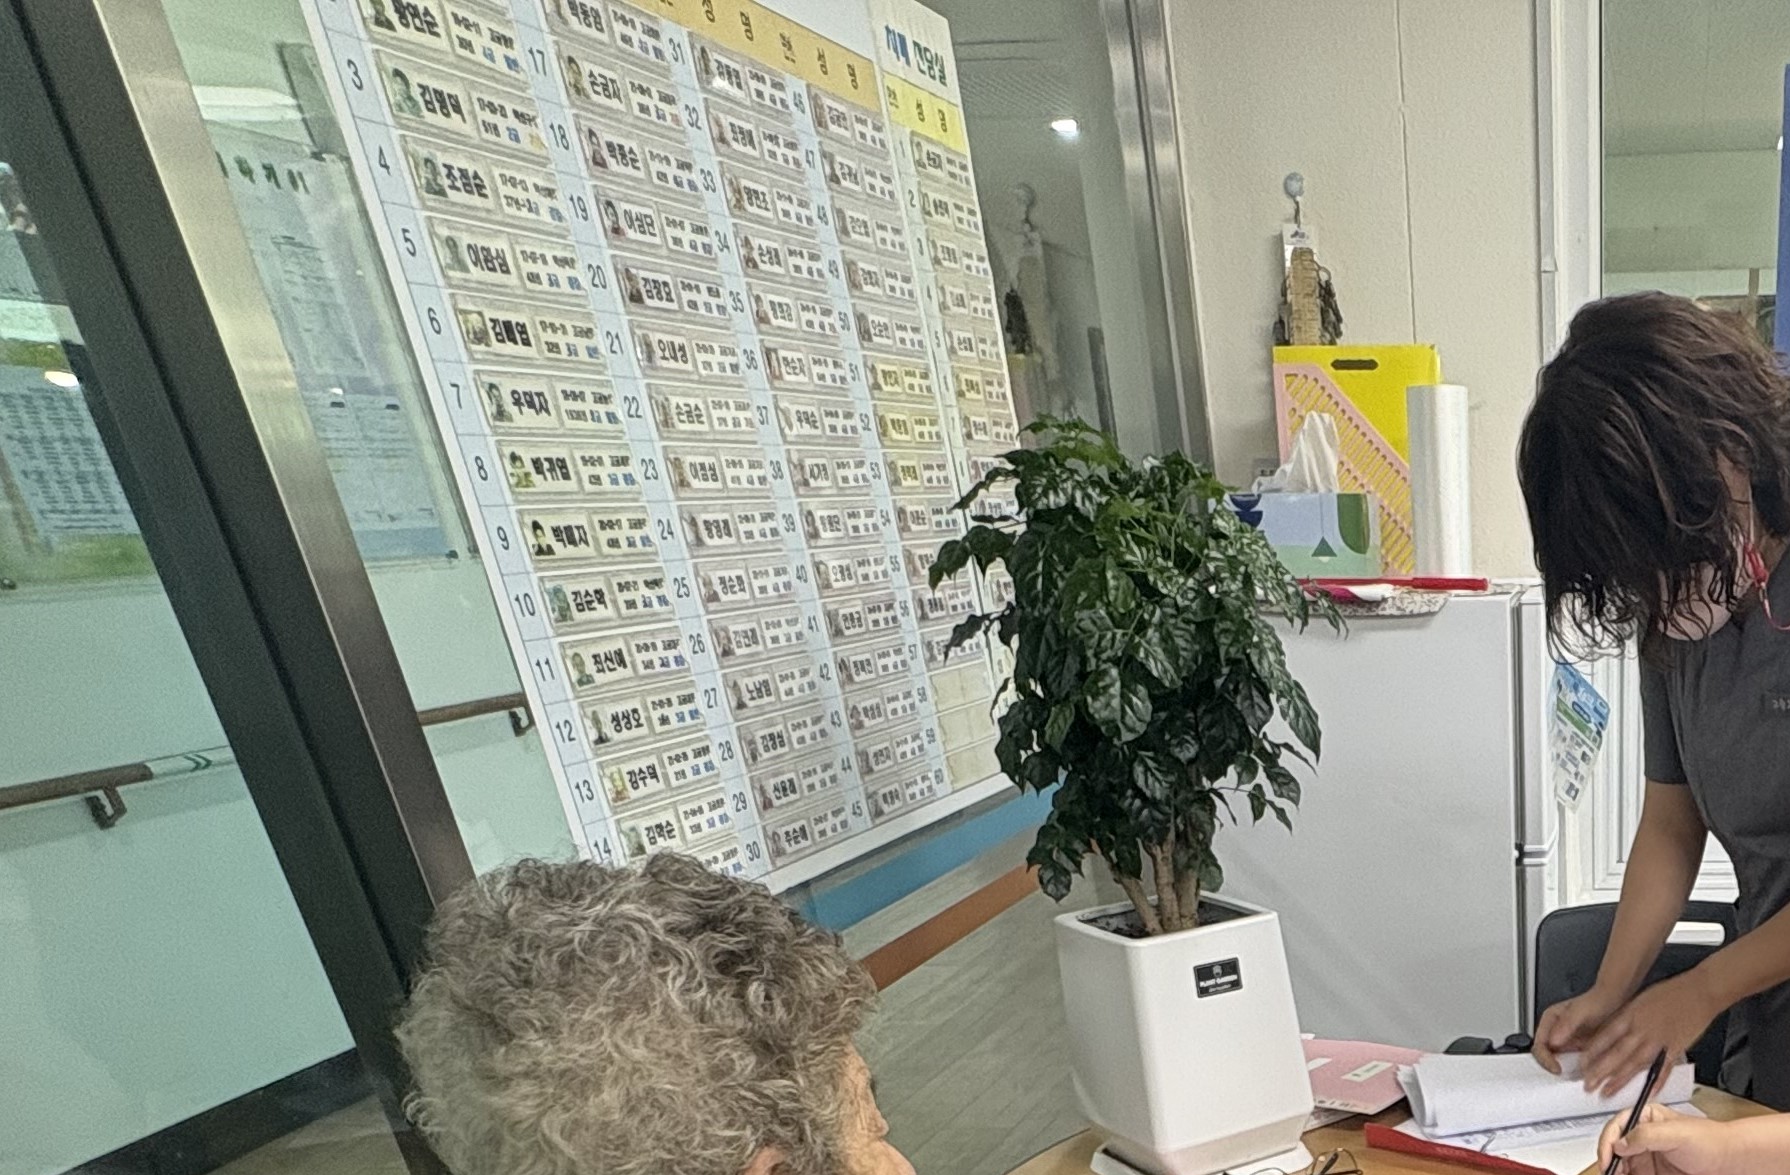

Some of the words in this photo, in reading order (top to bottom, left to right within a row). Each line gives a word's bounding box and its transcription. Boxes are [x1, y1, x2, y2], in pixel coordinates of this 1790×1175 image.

[528, 47, 547, 76] 17
[669, 37, 685, 65] 31
[347, 59, 363, 91] 3
[684, 103, 702, 131] 32
[550, 123, 569, 150] 18
[378, 146, 391, 176] 4
[700, 168, 716, 194] 33
[569, 195, 588, 221] 19
[908, 189, 916, 207] 2
[401, 228, 416, 257] 5
[714, 230, 730, 252] 34
[588, 264, 607, 290] 20
[729, 291, 745, 314] 35
[428, 307, 442, 335] 6
[606, 331, 623, 354] 21
[743, 349, 758, 371] 36
[451, 383, 462, 409] 7
[624, 396, 642, 418] 22
[756, 405, 769, 426] 37
[474, 455, 488, 481] 8
[641, 458, 658, 480] 23
[769, 460, 784, 480] 38
[658, 519, 674, 541] 24
[782, 513, 796, 532] 39
[497, 526, 509, 550] 9
[795, 564, 808, 584] 40
[673, 576, 690, 599] 25
[515, 592, 536, 618] 10
[808, 615, 820, 633] 41
[689, 634, 705, 655] 26
[535, 657, 555, 682] 11
[819, 663, 832, 681] 42
[704, 688, 718, 709] 27
[830, 711, 842, 728] 43
[555, 720, 576, 744] 12
[718, 740, 734, 762] 28
[841, 757, 852, 773] 44
[574, 779, 595, 804] 13
[732, 792, 749, 812] 29
[851, 802, 863, 818] 45
[594, 837, 612, 859] 14
[745, 841, 762, 862] 30
